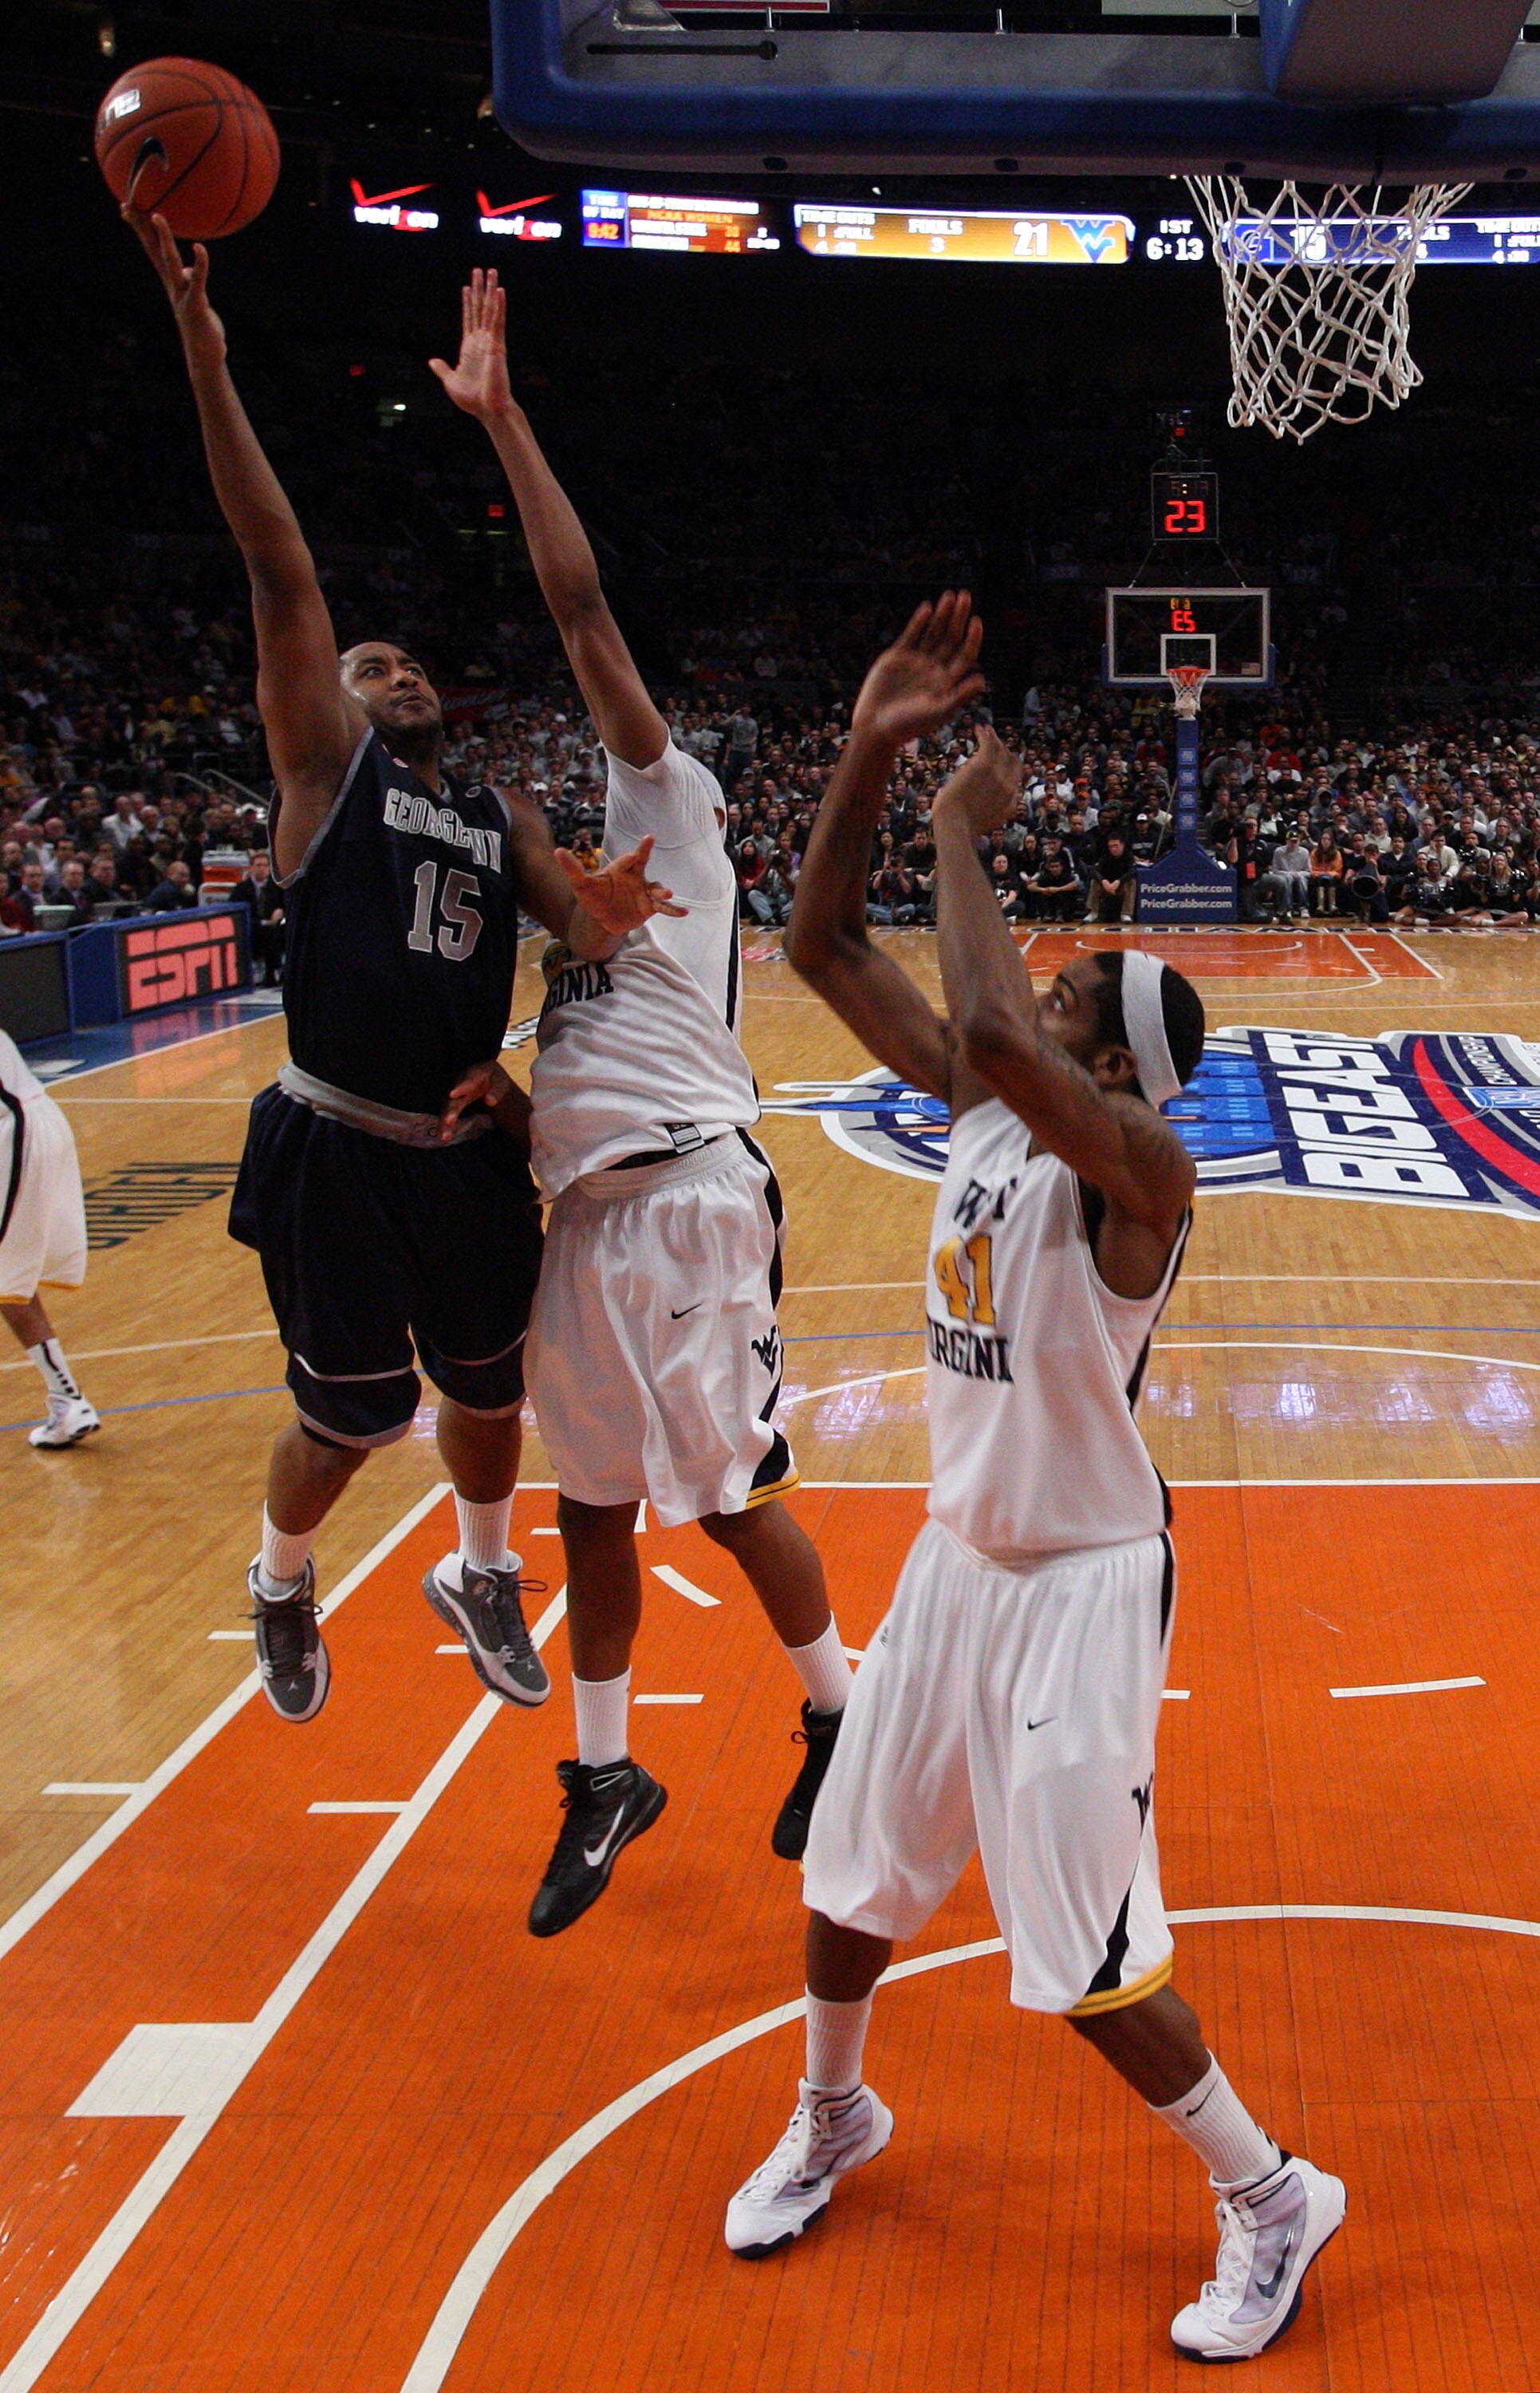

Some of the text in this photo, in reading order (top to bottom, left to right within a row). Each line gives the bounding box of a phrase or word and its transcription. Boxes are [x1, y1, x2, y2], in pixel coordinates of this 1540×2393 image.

[908, 219, 963, 235] FOULS
[1013, 221, 1050, 256] 21
[1147, 238, 1204, 262] 6:13
[1164, 500, 1205, 533] 23
[1140, 883, 1232, 893] PriceGrabber.com
[1140, 899, 1232, 909] PriceGrabber.com
[408, 860, 484, 962] 15
[125, 915, 239, 1011] ESPN
[1262, 1032, 1471, 1196] BIG EAST
[934, 1235, 996, 1326] 41
